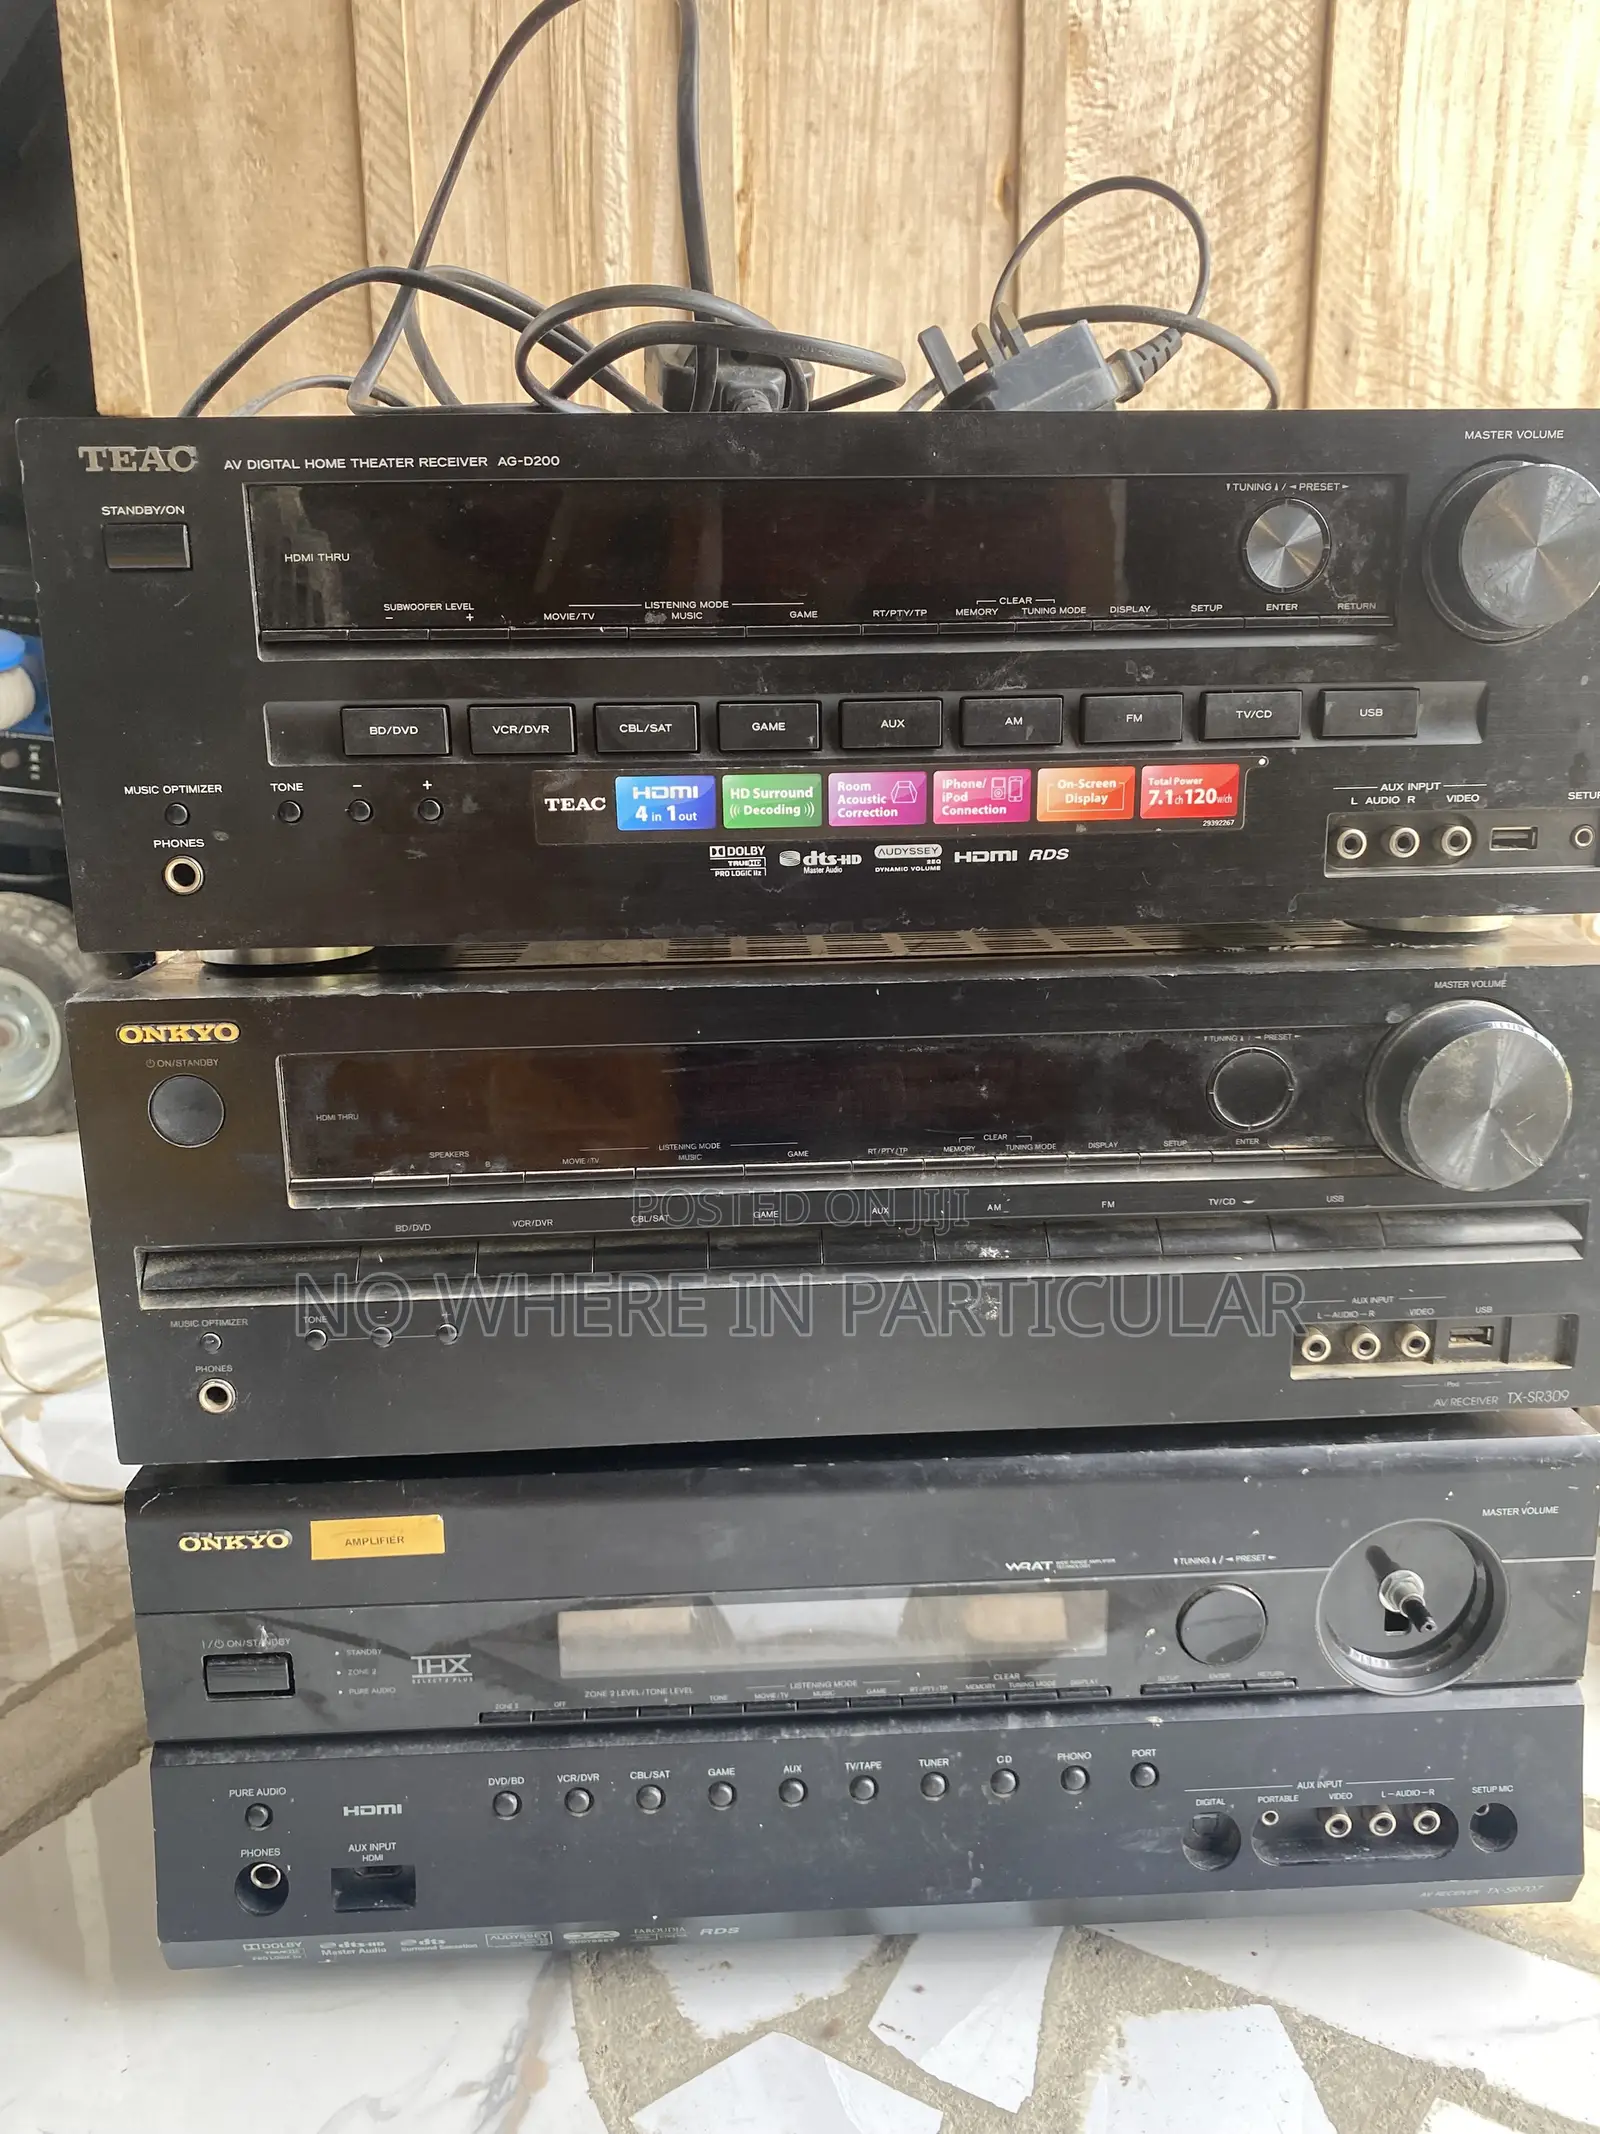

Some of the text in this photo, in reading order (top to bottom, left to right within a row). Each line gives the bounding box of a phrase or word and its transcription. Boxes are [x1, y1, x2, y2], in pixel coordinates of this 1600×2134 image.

[1465, 430, 1564, 440] MASTER VOLUME
[78, 445, 198, 473] TEAC
[224, 455, 560, 470] AV DIGITAL HOME THEATER RECEIVER AG-D200
[1233, 482, 1341, 491] TUNING PRESET
[101, 505, 185, 516] STANDBY/ON
[285, 553, 350, 562] HDMI THRU
[645, 600, 729, 610] LISTENING MODE
[999, 597, 1032, 605] CLEAR
[1337, 602, 1376, 610] RETURN
[384, 602, 474, 612] SUBWOOFER LEVEL
[955, 607, 998, 616] MEMORY
[1022, 606, 1087, 616] TUNING MODE
[1110, 605, 1151, 613] DISPLAY
[1190, 604, 1223, 612] SETUP
[1266, 603, 1298, 611] ENTER
[543, 612, 595, 621] MOVIE/TV
[671, 612, 703, 620] MUSIC
[789, 610, 818, 619] GAME
[873, 609, 928, 618] RT/PTY/TP
[1236, 709, 1272, 720] TV/CD
[1359, 707, 1384, 719] USB
[880, 718, 905, 729] AUX
[1005, 716, 1024, 726] AM
[1126, 713, 1143, 724] FM
[369, 725, 419, 735] BD/DVD
[492, 724, 550, 735] VCR/DVR
[619, 723, 673, 734] CBL/SAT
[752, 722, 786, 732] GAME
[837, 781, 871, 792] Room
[942, 777, 986, 789] iPhone/
[1058, 778, 1117, 789] On-Screen
[1148, 777, 1203, 786] Total Power
[124, 784, 223, 795] MUSIC OPTIMIZER
[270, 782, 304, 792] TONE
[1380, 782, 1441, 792] AUX INPUT
[633, 786, 699, 799] HDMI
[731, 787, 813, 799] HD Surround
[837, 793, 887, 805] Acoustic
[1065, 793, 1108, 805] Display
[1351, 795, 1416, 805] L AUDIO R
[1446, 794, 1480, 803] VIDEO
[544, 797, 606, 812] TEAC
[635, 805, 662, 822] 4 in
[744, 804, 801, 817] Decoding
[837, 807, 898, 818] Correction
[942, 804, 1007, 816] Connection
[1202, 819, 1235, 827] 29392267
[153, 839, 205, 848] PHONES
[727, 846, 766, 856] DOLBY
[878, 846, 939, 856] AUDYSSEY
[1028, 848, 1069, 861] RDS
[803, 851, 862, 865] dts-HD
[954, 850, 1018, 863] HDMI
[803, 866, 843, 875] Master Audio
[1434, 980, 1507, 989] MASTER VOLUME
[118, 1022, 240, 1045] ONKYO
[157, 1058, 219, 1068] ON/STANDBY
[338, 1113, 359, 1121] THRU
[983, 1133, 1007, 1141] CLEAR
[1235, 1138, 1260, 1146] ENTER
[658, 1142, 721, 1151] LISTENING MODE
[943, 1145, 976, 1153] MEMORY
[1035, 1142, 1057, 1150] MODE
[1163, 1140, 1188, 1148] SETUP
[429, 1151, 470, 1159] SPEAKERS
[678, 1153, 702, 1161] MUSIC
[787, 1150, 809, 1158] GAME
[1209, 1198, 1236, 1206] TV/CD
[1326, 1195, 1344, 1203] USB
[872, 1207, 889, 1215] AUX
[987, 1203, 1002, 1211] AM
[395, 1224, 431, 1232] BD/DVD
[512, 1218, 553, 1228] VCR/DVR
[1475, 1306, 1493, 1314] USB
[303, 1316, 328, 1324] TONE
[195, 1365, 233, 1373] PHONES
[1450, 1390, 1570, 1405] RECEIVER TX-SR309
[1482, 1506, 1559, 1517] MASTER VOLUME
[178, 1533, 290, 1552] ONKYO
[345, 1535, 405, 1546] AMPLIFIER
[1005, 1560, 1053, 1571] WRAT
[411, 1654, 472, 1677] THX
[1057, 1752, 1092, 1761] PHONO
[1132, 1749, 1156, 1758] PORT
[919, 1758, 949, 1767] TUNER
[997, 1755, 1012, 1764] CD
[783, 1765, 802, 1774] AUX
[845, 1761, 882, 1770] TV/TAPE
[557, 1773, 600, 1782] VCR/DVR
[630, 1770, 670, 1780] CBL/SAT
[708, 1768, 735, 1777] GAME
[488, 1776, 525, 1786] DVD/BD
[1297, 1780, 1342, 1789] AUX INPUT
[229, 1787, 287, 1797] PURE AUDIO
[1329, 1792, 1353, 1800] VIDEO
[1196, 1798, 1225, 1806] DIGITAL
[1258, 1794, 1299, 1803] PORTABLE
[343, 1803, 402, 1816] HDMI
[348, 1842, 397, 1852] AUX INPUT
[240, 1848, 281, 1857] PHONES
[700, 1926, 740, 1935] RDS
